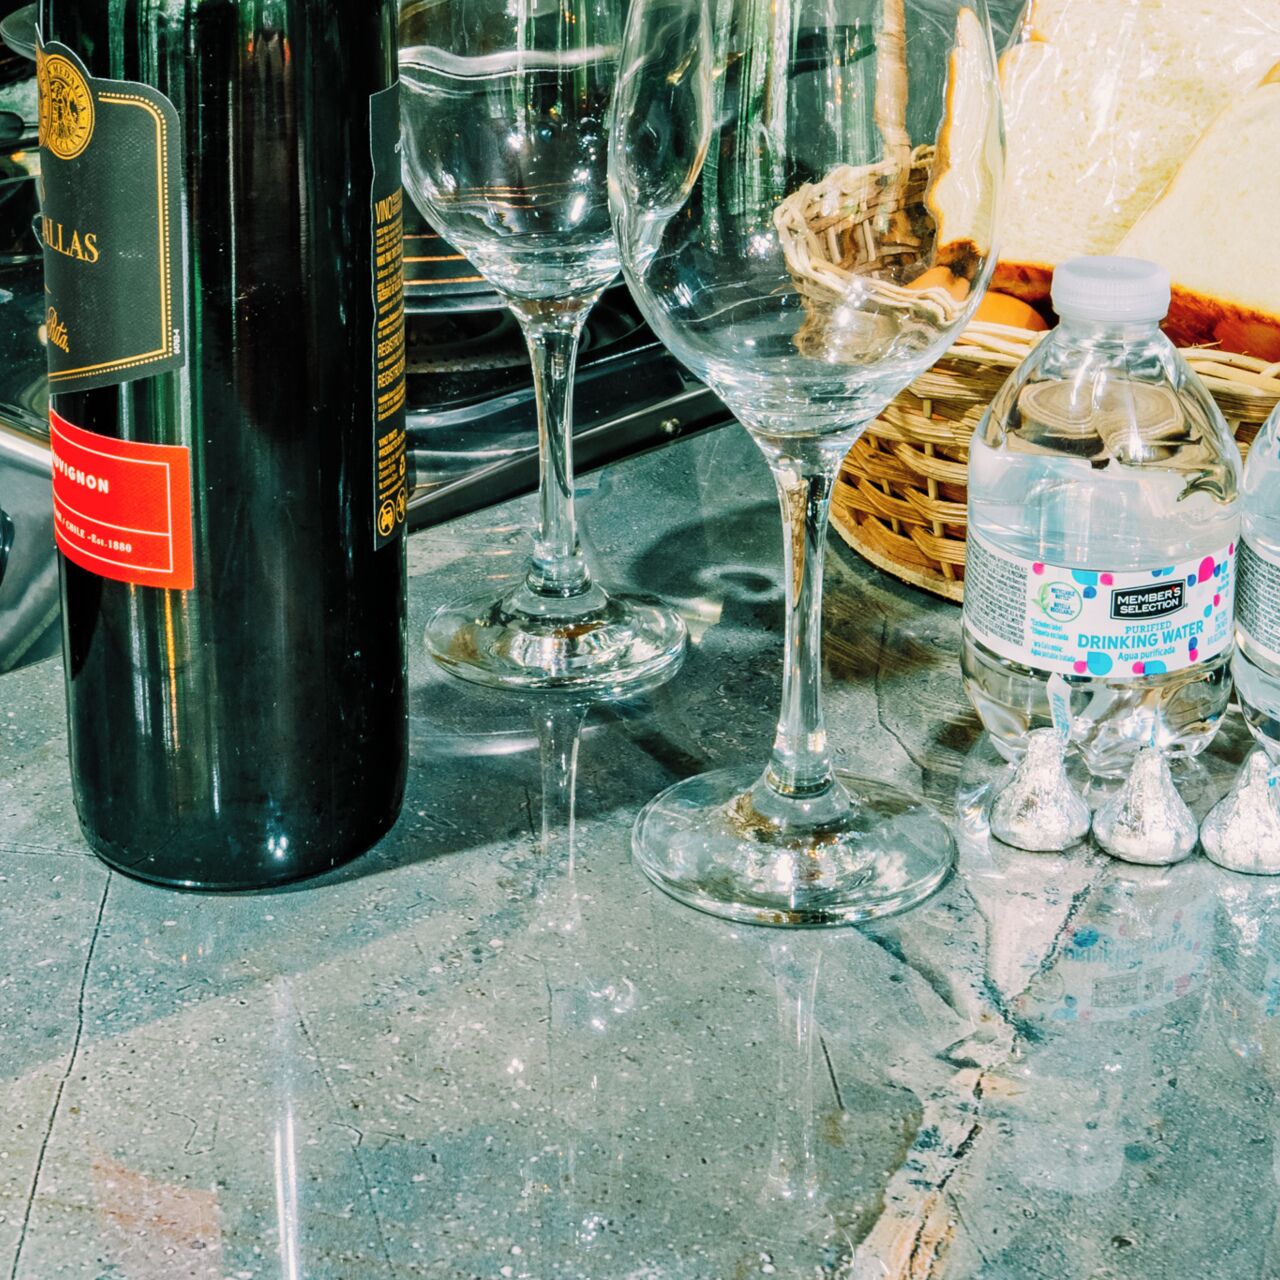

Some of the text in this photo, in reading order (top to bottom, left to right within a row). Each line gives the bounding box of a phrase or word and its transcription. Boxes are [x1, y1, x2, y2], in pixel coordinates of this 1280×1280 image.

[52, 453, 109, 494] UVIGNON
[1117, 586, 1181, 605] MEMBER'S
[1119, 597, 1179, 614] SELECTION
[1077, 631, 1159, 650] DRINKING
[1162, 620, 1204, 644] WATER
[1125, 620, 1173, 634] PURIFIED
[1117, 651, 1139, 663] Agua
